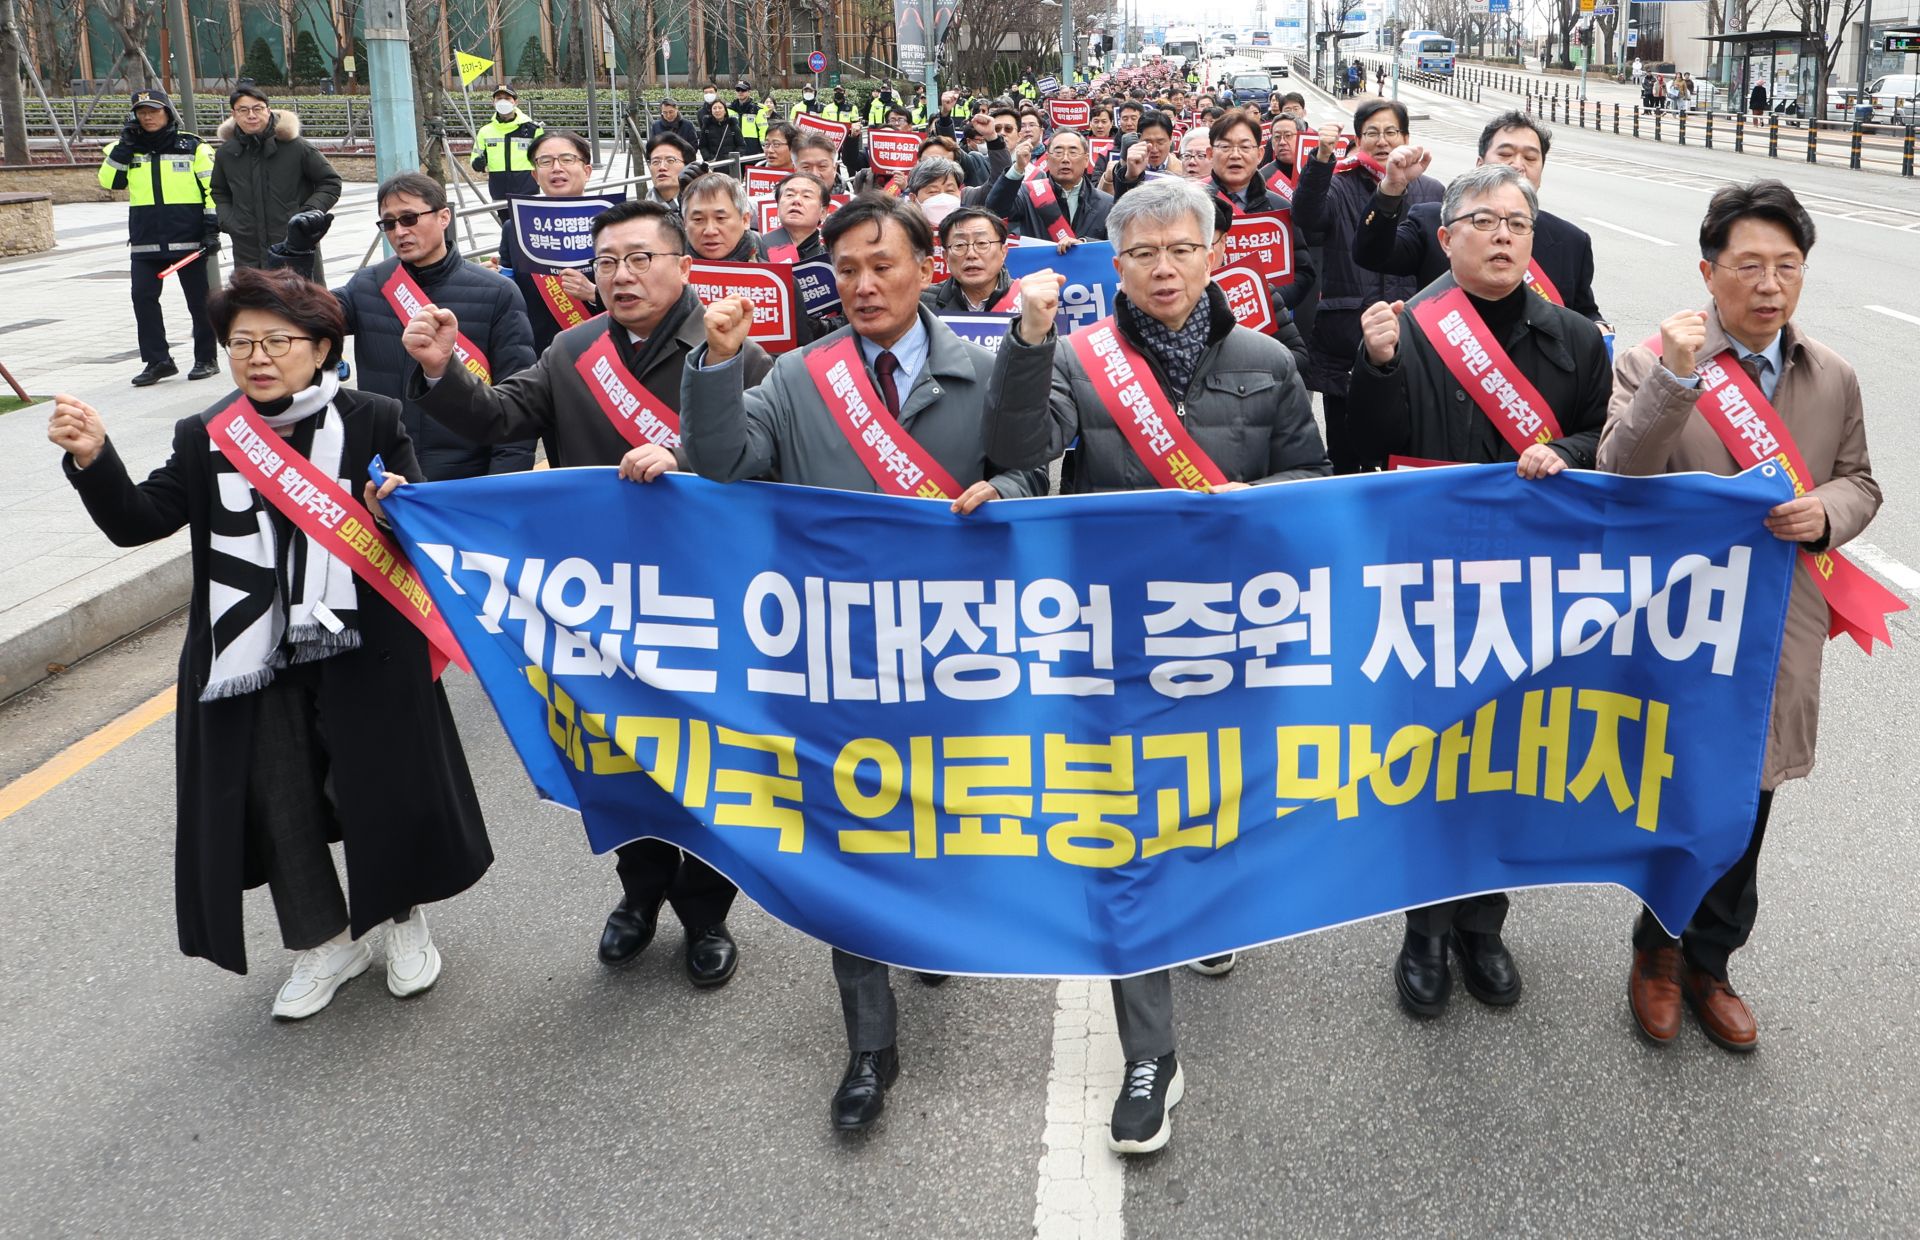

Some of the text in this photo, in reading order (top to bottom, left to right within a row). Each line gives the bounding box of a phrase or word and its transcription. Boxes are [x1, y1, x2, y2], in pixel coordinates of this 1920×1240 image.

[529, 233, 562, 251] 정부는
[533, 217, 553, 233] 9.4
[1238, 230, 1281, 250] 수요조사
[1224, 280, 1255, 304] 추진
[591, 355, 641, 420] 의대정원
[1087, 326, 1135, 388] 일방적인
[1118, 380, 1176, 456] 정책추진
[1437, 309, 1494, 377] 일방적인
[1480, 367, 1543, 437] 정책추진
[1716, 383, 1780, 460] 확대추진
[825, 359, 872, 430] 일방적인
[861, 419, 925, 491] 정책추진
[224, 415, 433, 619] 의대정원 확대추진 의료체계 붕괴된다
[742, 570, 1115, 703] 의대정원
[1143, 566, 1333, 699] 증원
[1360, 545, 1753, 689] 저지하여
[832, 726, 1242, 869] 의료붕괴
[1275, 686, 1675, 832] 막아내자
